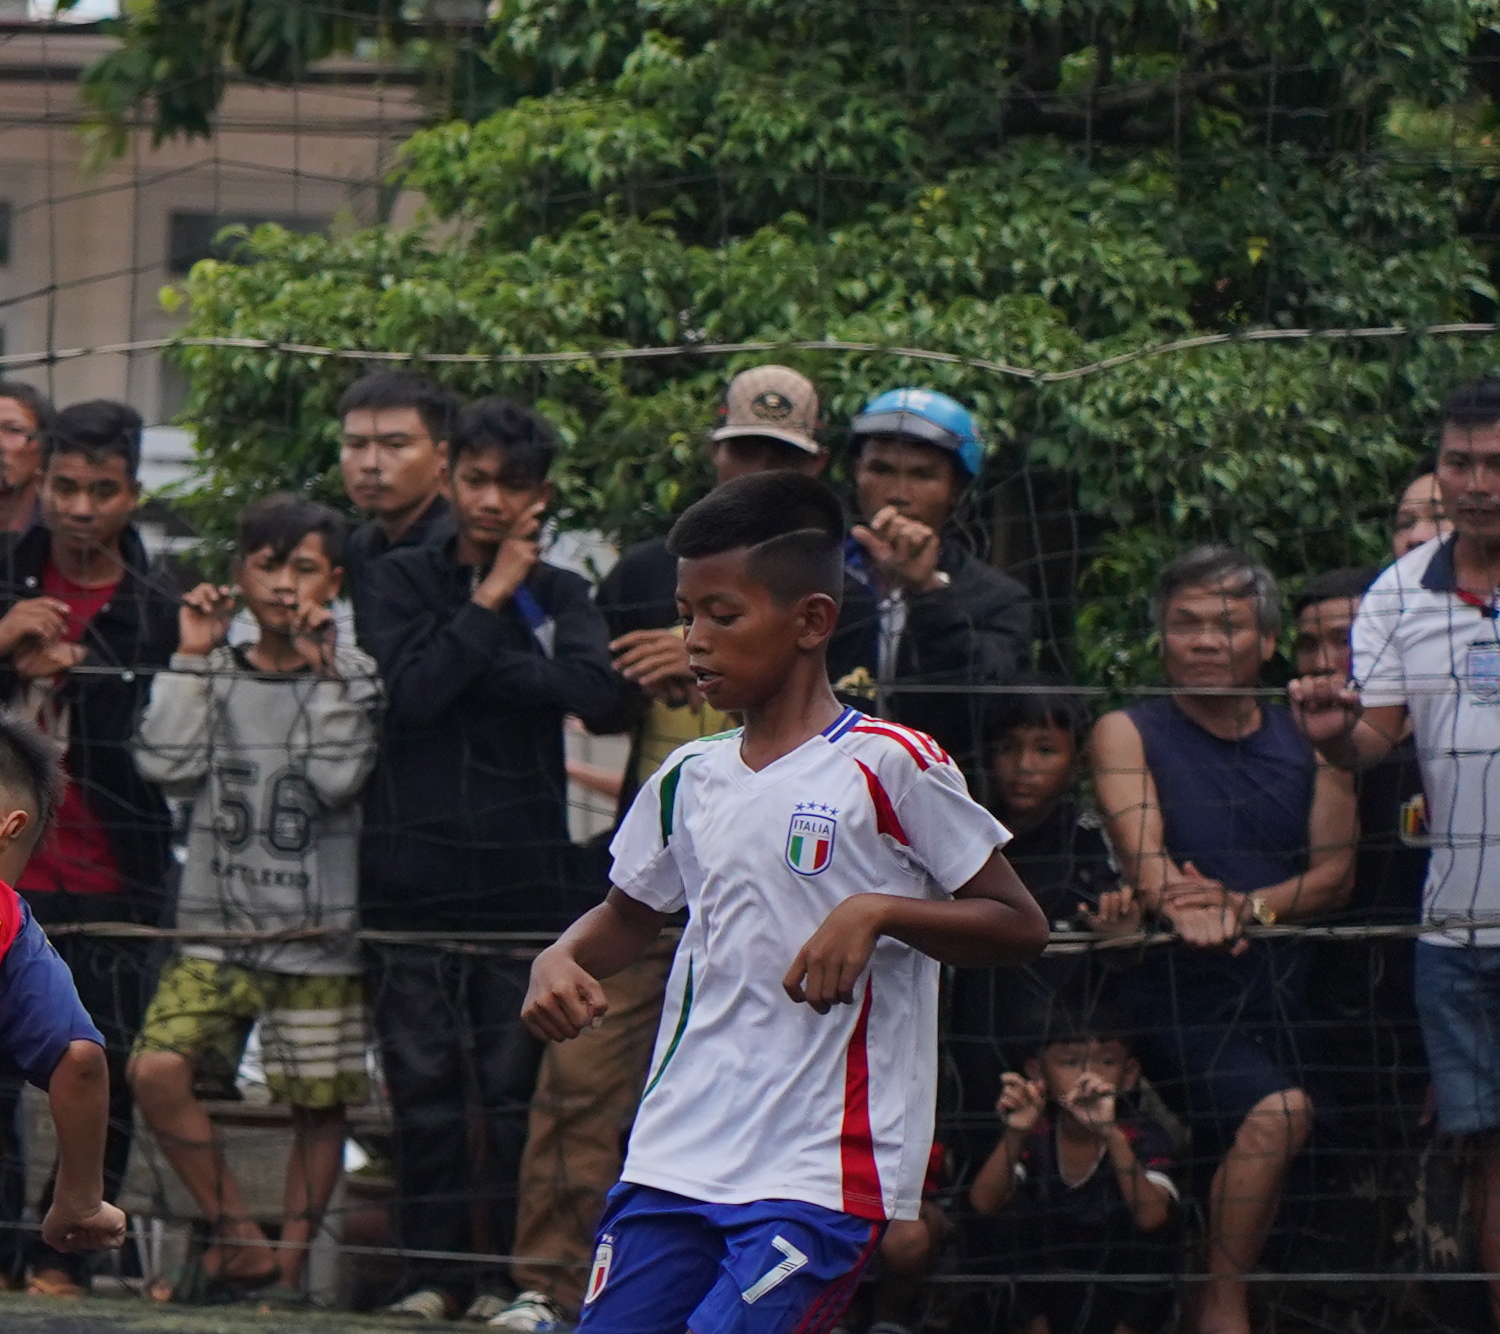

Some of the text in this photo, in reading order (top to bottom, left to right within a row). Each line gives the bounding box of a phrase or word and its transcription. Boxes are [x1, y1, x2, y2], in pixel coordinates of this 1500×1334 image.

[214, 759, 324, 862] 56
[794, 819, 830, 835] ITALIA
[741, 1235, 809, 1305] 7
